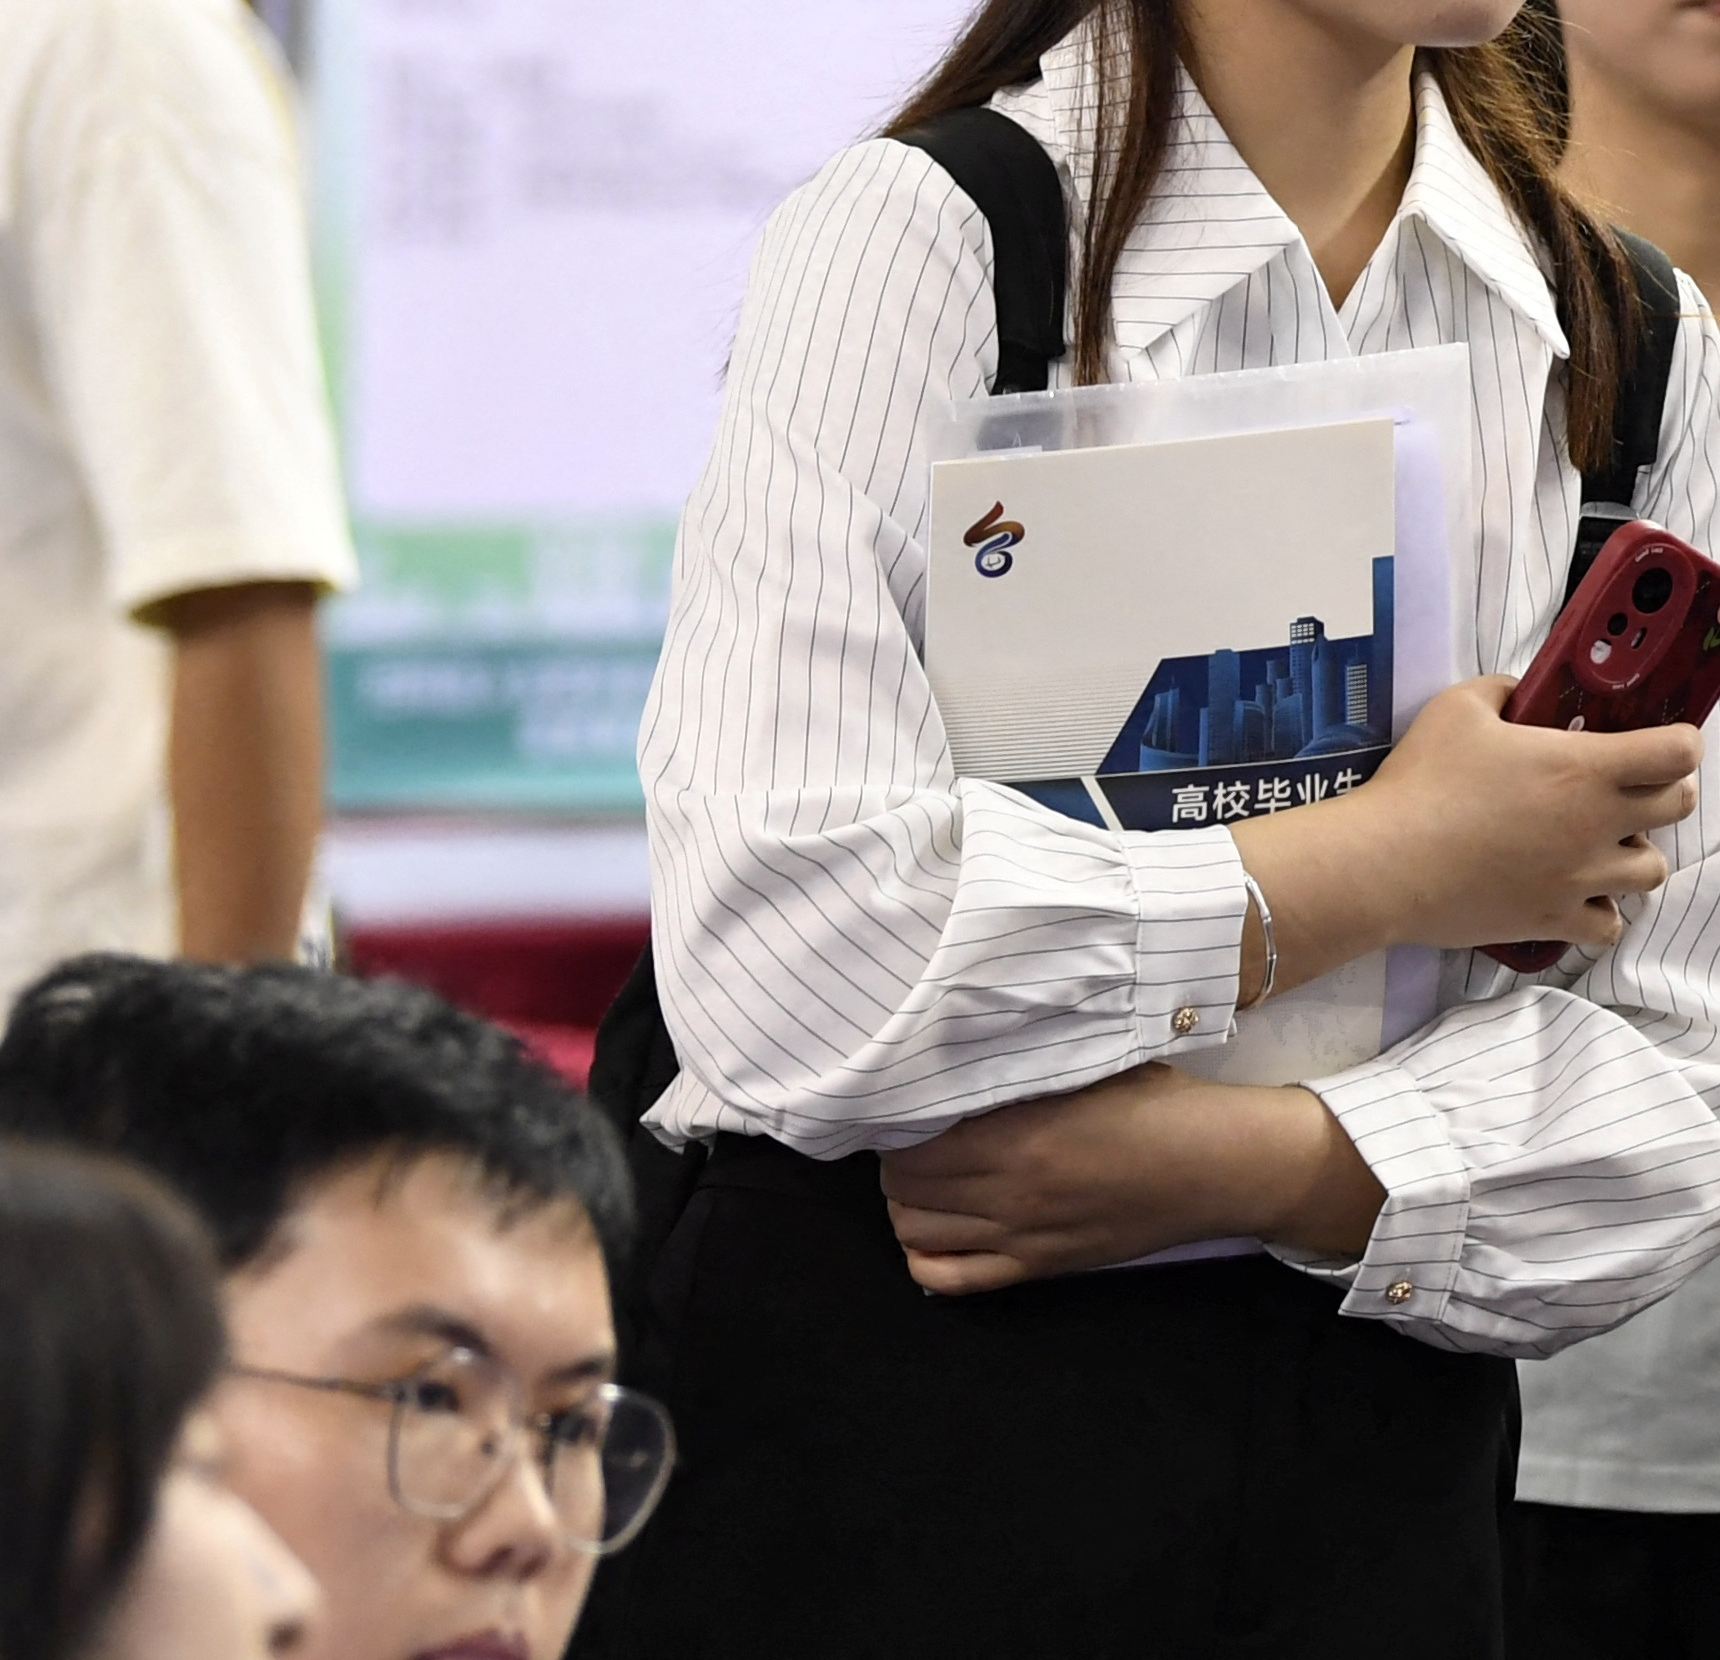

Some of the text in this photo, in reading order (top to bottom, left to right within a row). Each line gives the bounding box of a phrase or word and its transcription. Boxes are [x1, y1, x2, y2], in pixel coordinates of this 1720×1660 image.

[1171, 768, 1362, 823] 高校毕业生
